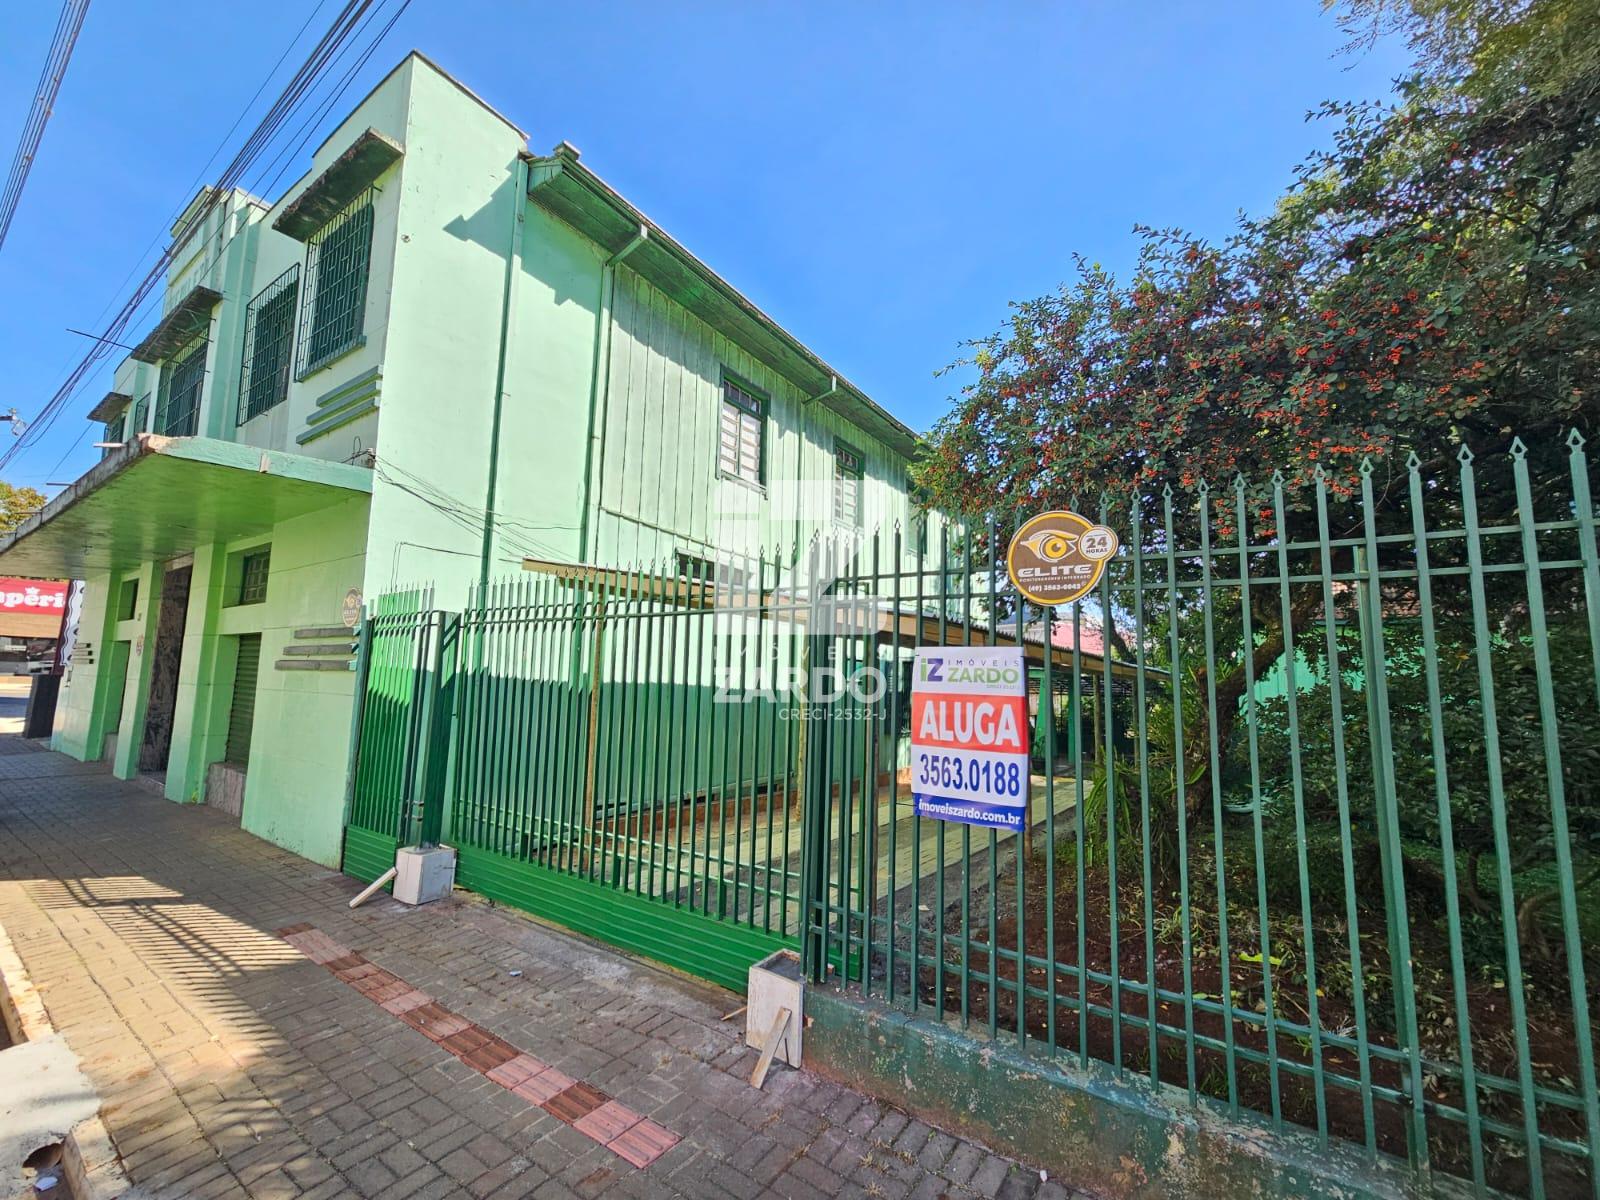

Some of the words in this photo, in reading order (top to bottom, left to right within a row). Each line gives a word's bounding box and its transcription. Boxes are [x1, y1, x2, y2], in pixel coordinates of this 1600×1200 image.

[1086, 536, 1107, 548] 24
[1017, 564, 1092, 578] ELITE
[948, 658, 1019, 667] IMÓVEIS
[947, 667, 1019, 684] ZARDO
[919, 699, 1021, 747] ALUGA
[919, 753, 1020, 797] 3563.0188
[918, 798, 1021, 825] imoveiszardo.com.br
